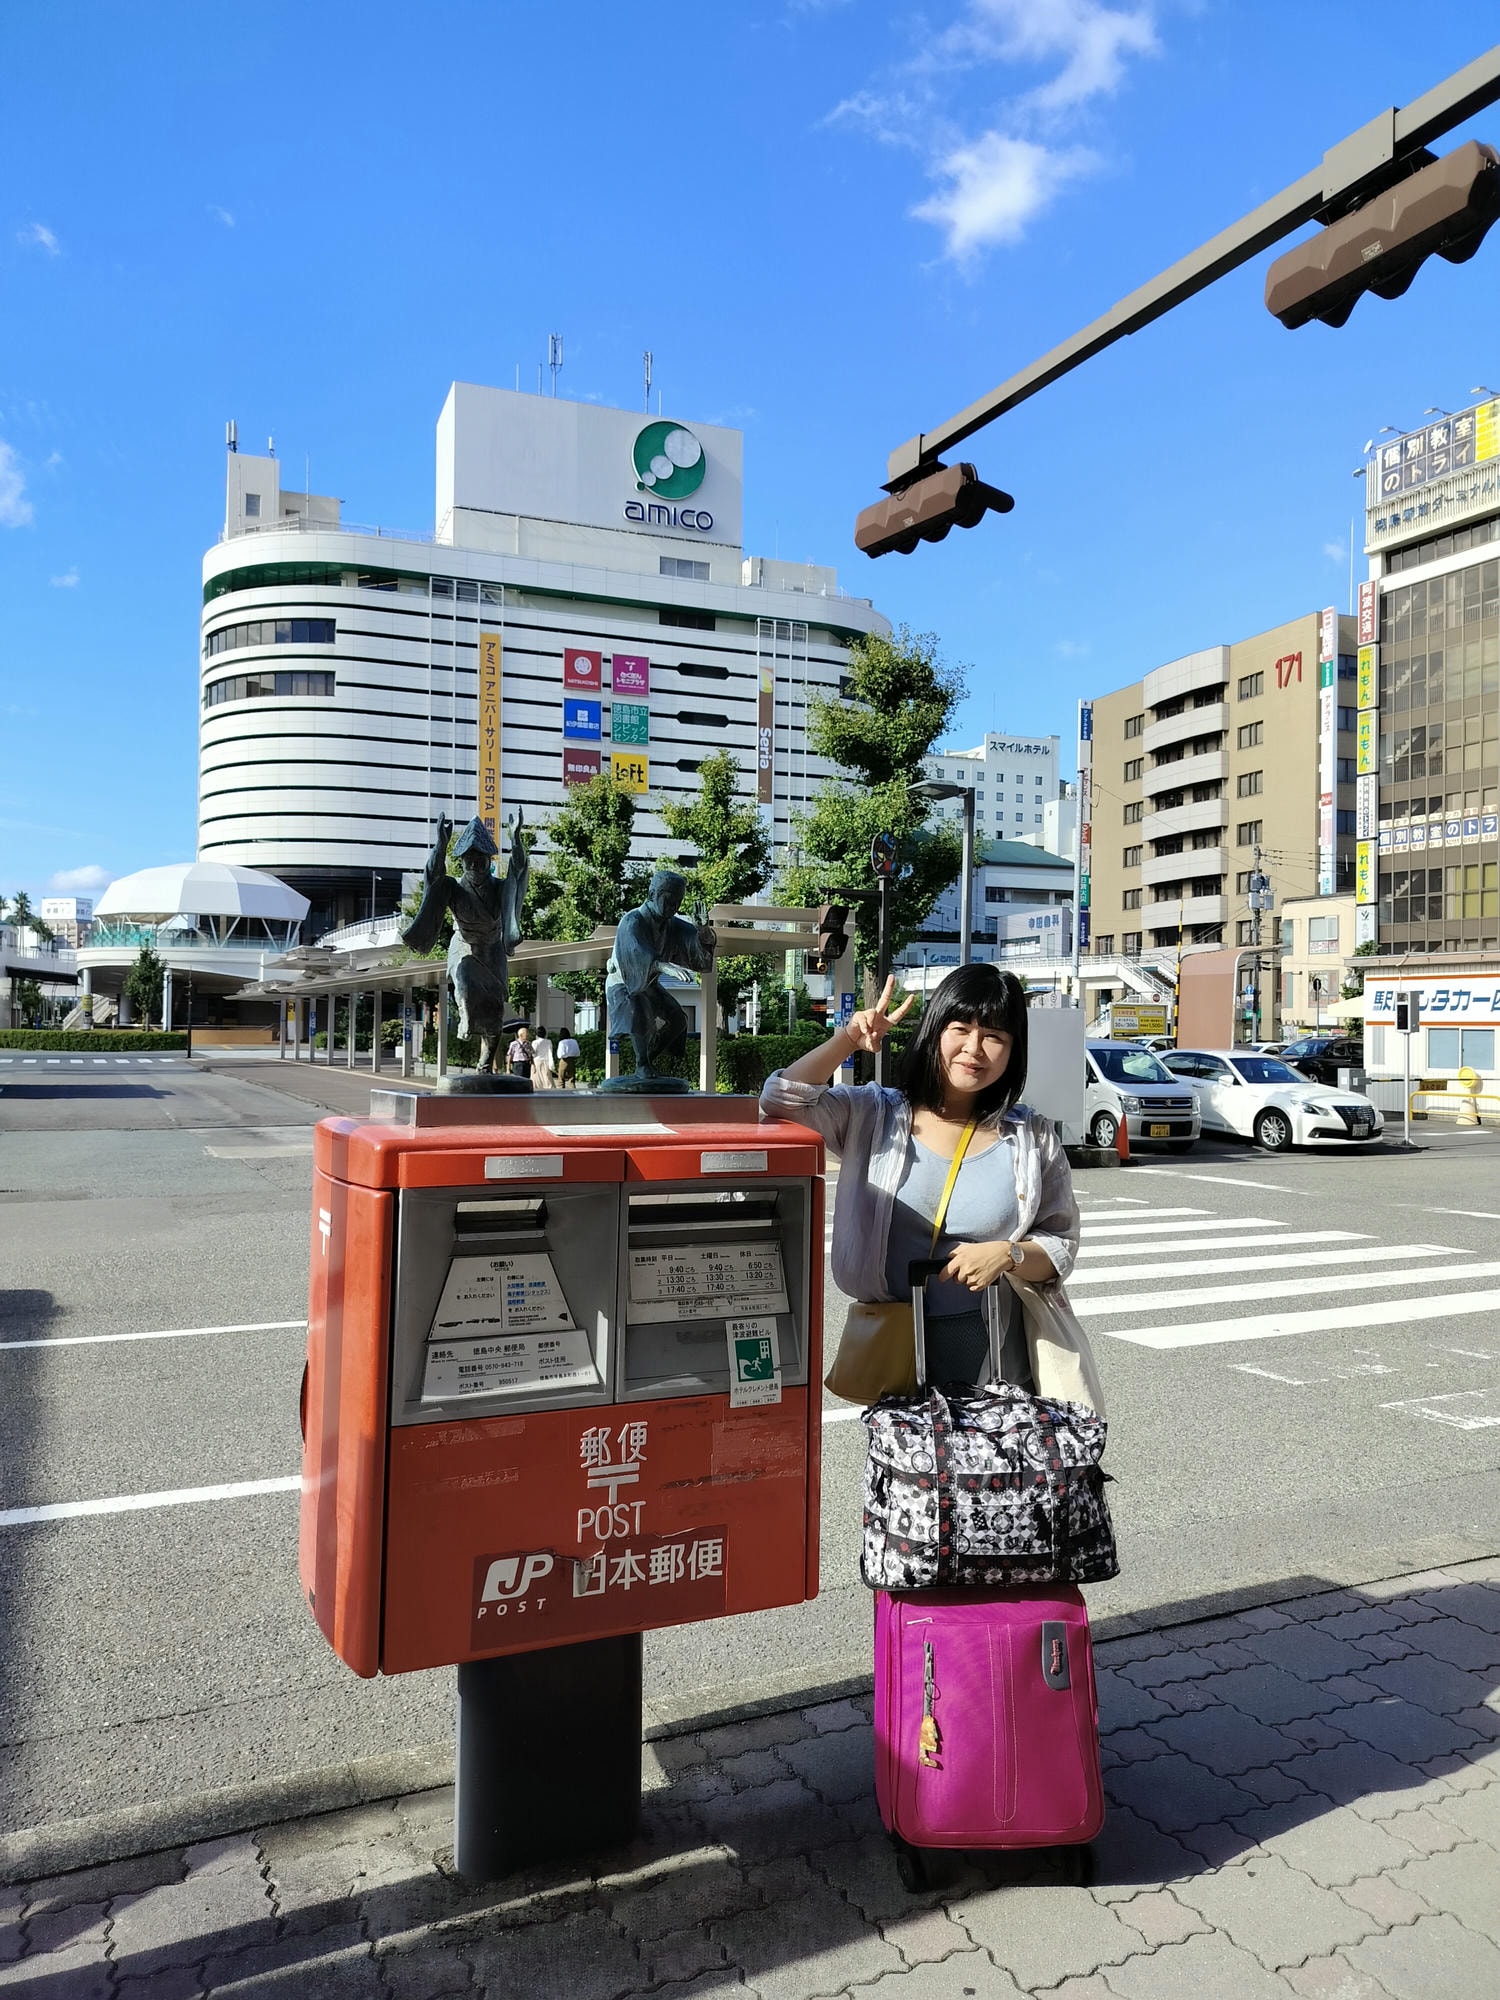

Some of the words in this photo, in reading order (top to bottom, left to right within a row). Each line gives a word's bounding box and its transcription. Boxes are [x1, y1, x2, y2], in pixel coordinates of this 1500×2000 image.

[1384, 416, 1473, 469] 個別教室
[1384, 443, 1471, 491] のトライ
[624, 501, 713, 531] amico
[485, 641, 496, 676] アミコ
[1275, 651, 1303, 690] 171
[1360, 658, 1370, 702] れもん
[484, 681, 496, 763] アニバーサリー
[613, 714, 640, 725] 図書館
[613, 724, 648, 735] シビック
[613, 733, 648, 742] センター
[760, 727, 772, 769] Seria
[989, 740, 1050, 756] スマイルホテル
[1360, 724, 1370, 766] れもん
[567, 763, 598, 774] 無印良品
[484, 767, 496, 811] FESTA
[1359, 854, 1369, 896] れもん
[666, 1275, 685, 1283] 13:30
[745, 1271, 763, 1279] 13:20
[669, 1265, 684, 1273] 9:40
[708, 1263, 723, 1271] 9:40
[748, 1261, 762, 1269] 6:50
[667, 1286, 685, 1294] 17:40
[706, 1283, 725, 1291] 17:40
[732, 1322, 758, 1330] 最寄りの
[733, 1329, 771, 1338] 津波避難ビル
[431, 1350, 454, 1359] 連絡先
[473, 1346, 502, 1355] 徳島中央
[504, 1343, 526, 1352] 郵便局
[538, 1341, 561, 1349] 郵便番号
[458, 1364, 484, 1374] 電話番号
[538, 1356, 567, 1365] ポスト住所
[459, 1381, 485, 1390] ポスト番号
[580, 1421, 648, 1468] 郵便
[577, 1501, 647, 1543] POST
[481, 1554, 554, 1602] JP
[572, 1538, 723, 1598] 日本郵便
[477, 1598, 546, 1619] POST
